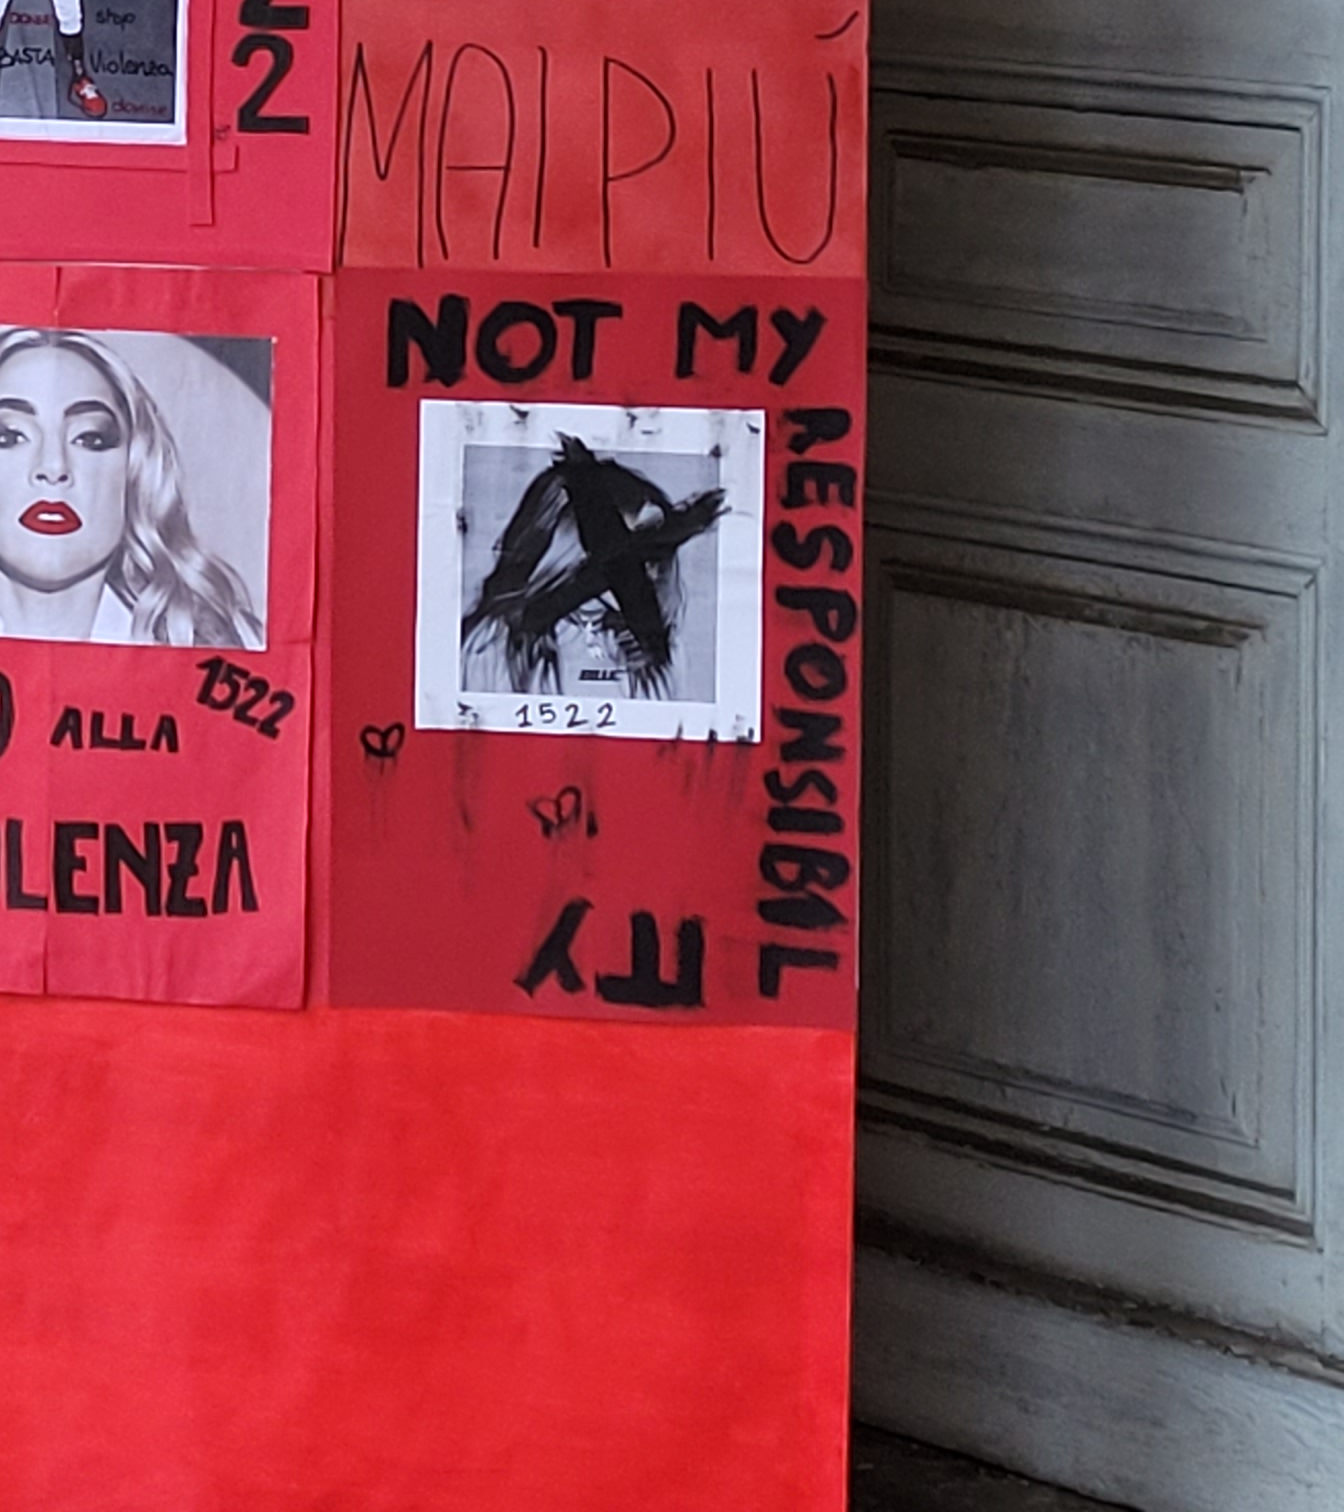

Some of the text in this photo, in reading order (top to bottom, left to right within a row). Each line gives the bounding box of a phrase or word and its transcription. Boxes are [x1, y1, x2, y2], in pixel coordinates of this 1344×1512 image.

[89, 49, 175, 78] Violenza
[336, 38, 548, 270] MAI
[386, 294, 828, 388] NOT MY
[49, 705, 180, 754] ALLA
[194, 653, 296, 741] 1522
[515, 700, 618, 729] 1522
